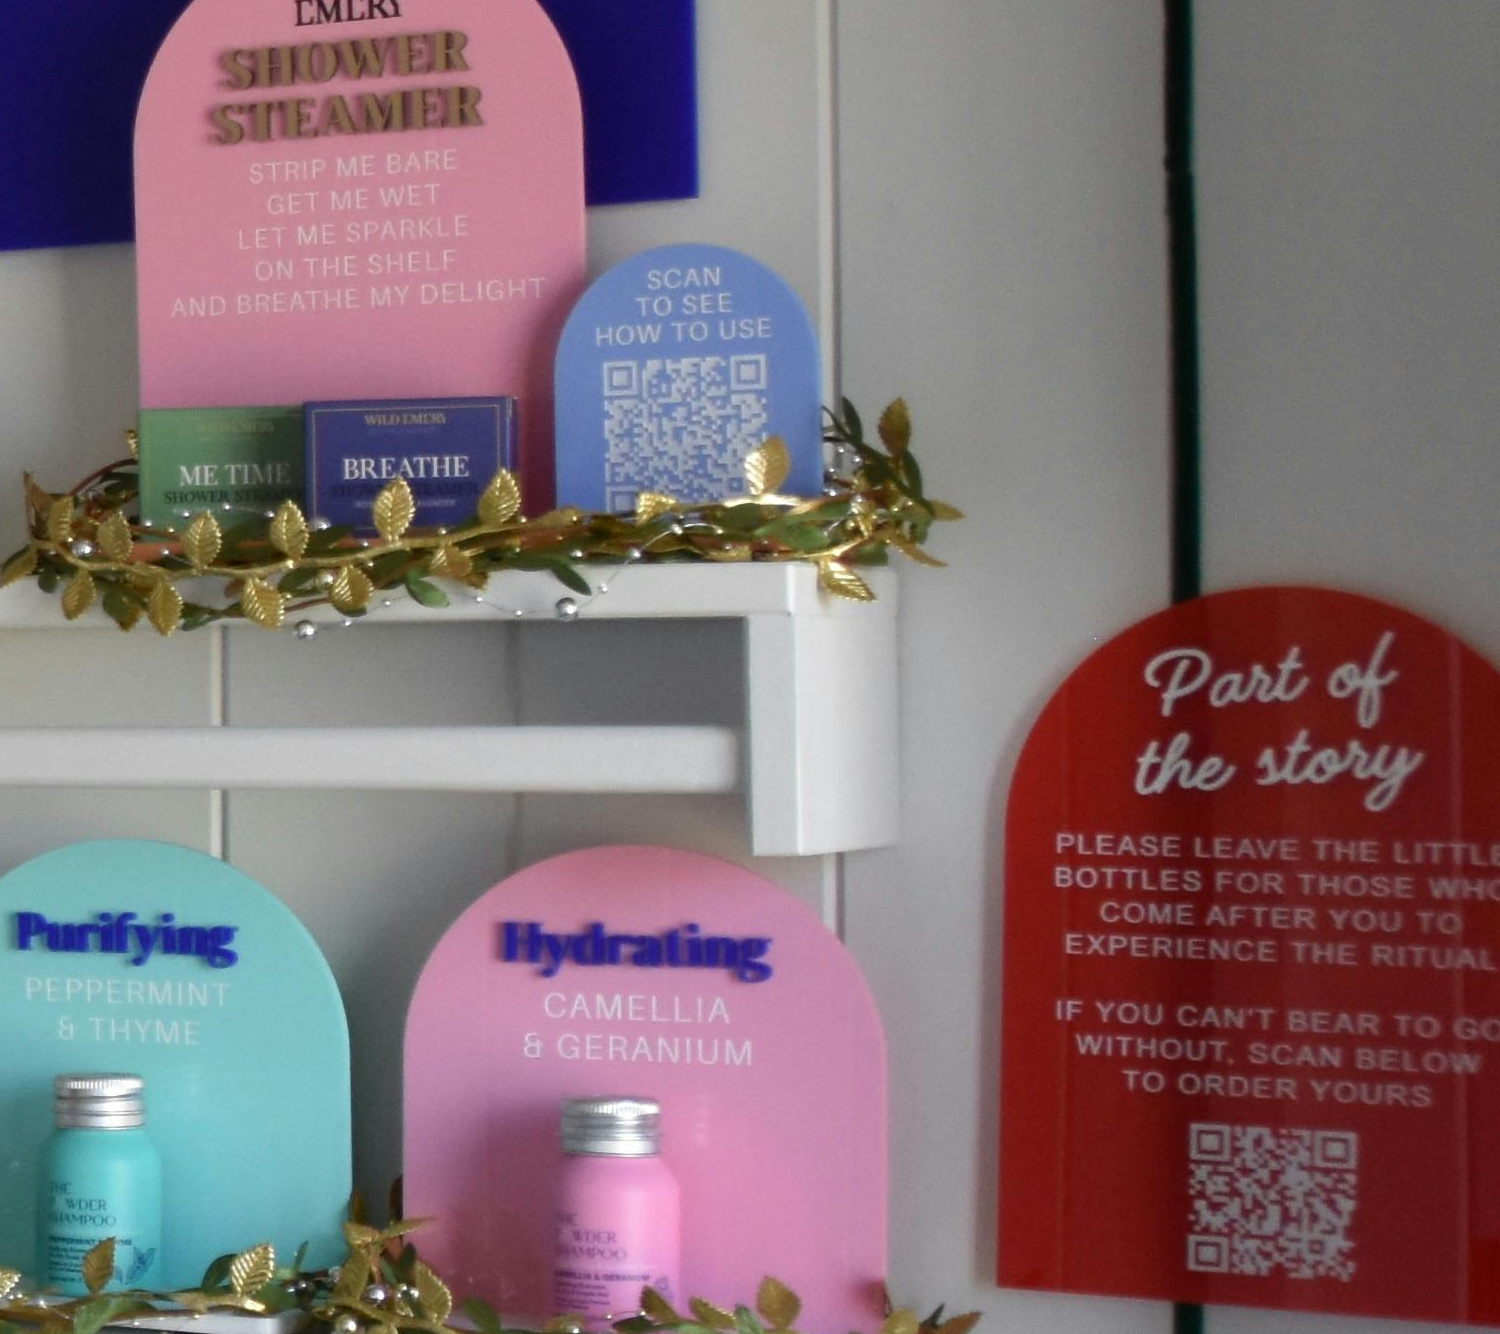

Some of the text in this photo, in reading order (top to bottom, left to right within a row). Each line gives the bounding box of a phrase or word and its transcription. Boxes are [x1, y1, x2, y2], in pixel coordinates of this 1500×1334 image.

[217, 31, 470, 90] SHOWER
[208, 86, 483, 144] STEAMER
[249, 150, 457, 184] STRIP ME BARE
[267, 184, 440, 215] GET ME WET
[239, 215, 468, 250] LET ME SPARKLE
[255, 250, 457, 282] ON THE SHELF
[648, 267, 720, 290] SCAN
[171, 277, 546, 318] AND BREATHE MY DELIGHT
[637, 294, 732, 316] TO SEE
[596, 318, 772, 347] HOW TO USE
[364, 414, 400, 426] WILD
[180, 463, 291, 486] ME TIME
[342, 455, 470, 480] BREATHE
[1144, 631, 1399, 729] Part of
[1134, 730, 1426, 812] the story
[1056, 833, 1181, 858] PLEASE
[1194, 837, 1298, 861] LEAVE
[1313, 840, 1379, 863] THE
[1054, 867, 1202, 892] BOTTLES
[1215, 871, 1284, 895] FOR
[1297, 873, 1414, 898] THOSE
[1100, 902, 1463, 935] COME AFTER YOU TO
[14, 911, 239, 969] Purifying
[497, 921, 773, 984] Hydrating
[1064, 933, 1277, 963] EXPERIENCE
[1292, 942, 1358, 966] THE
[27, 977, 231, 1008] PEPPERMINT
[543, 993, 731, 1025] CAMELLIA
[59, 1018, 200, 1046] & THYME
[1056, 1000, 1500, 1042] IF YOU CAN'T BEAR TO GO
[523, 1032, 753, 1067] & GERANIUM
[1248, 1041, 1341, 1068] SCAN
[1353, 1047, 1483, 1075] BELOW
[1123, 1069, 1433, 1109] TO ORDER YOURS
